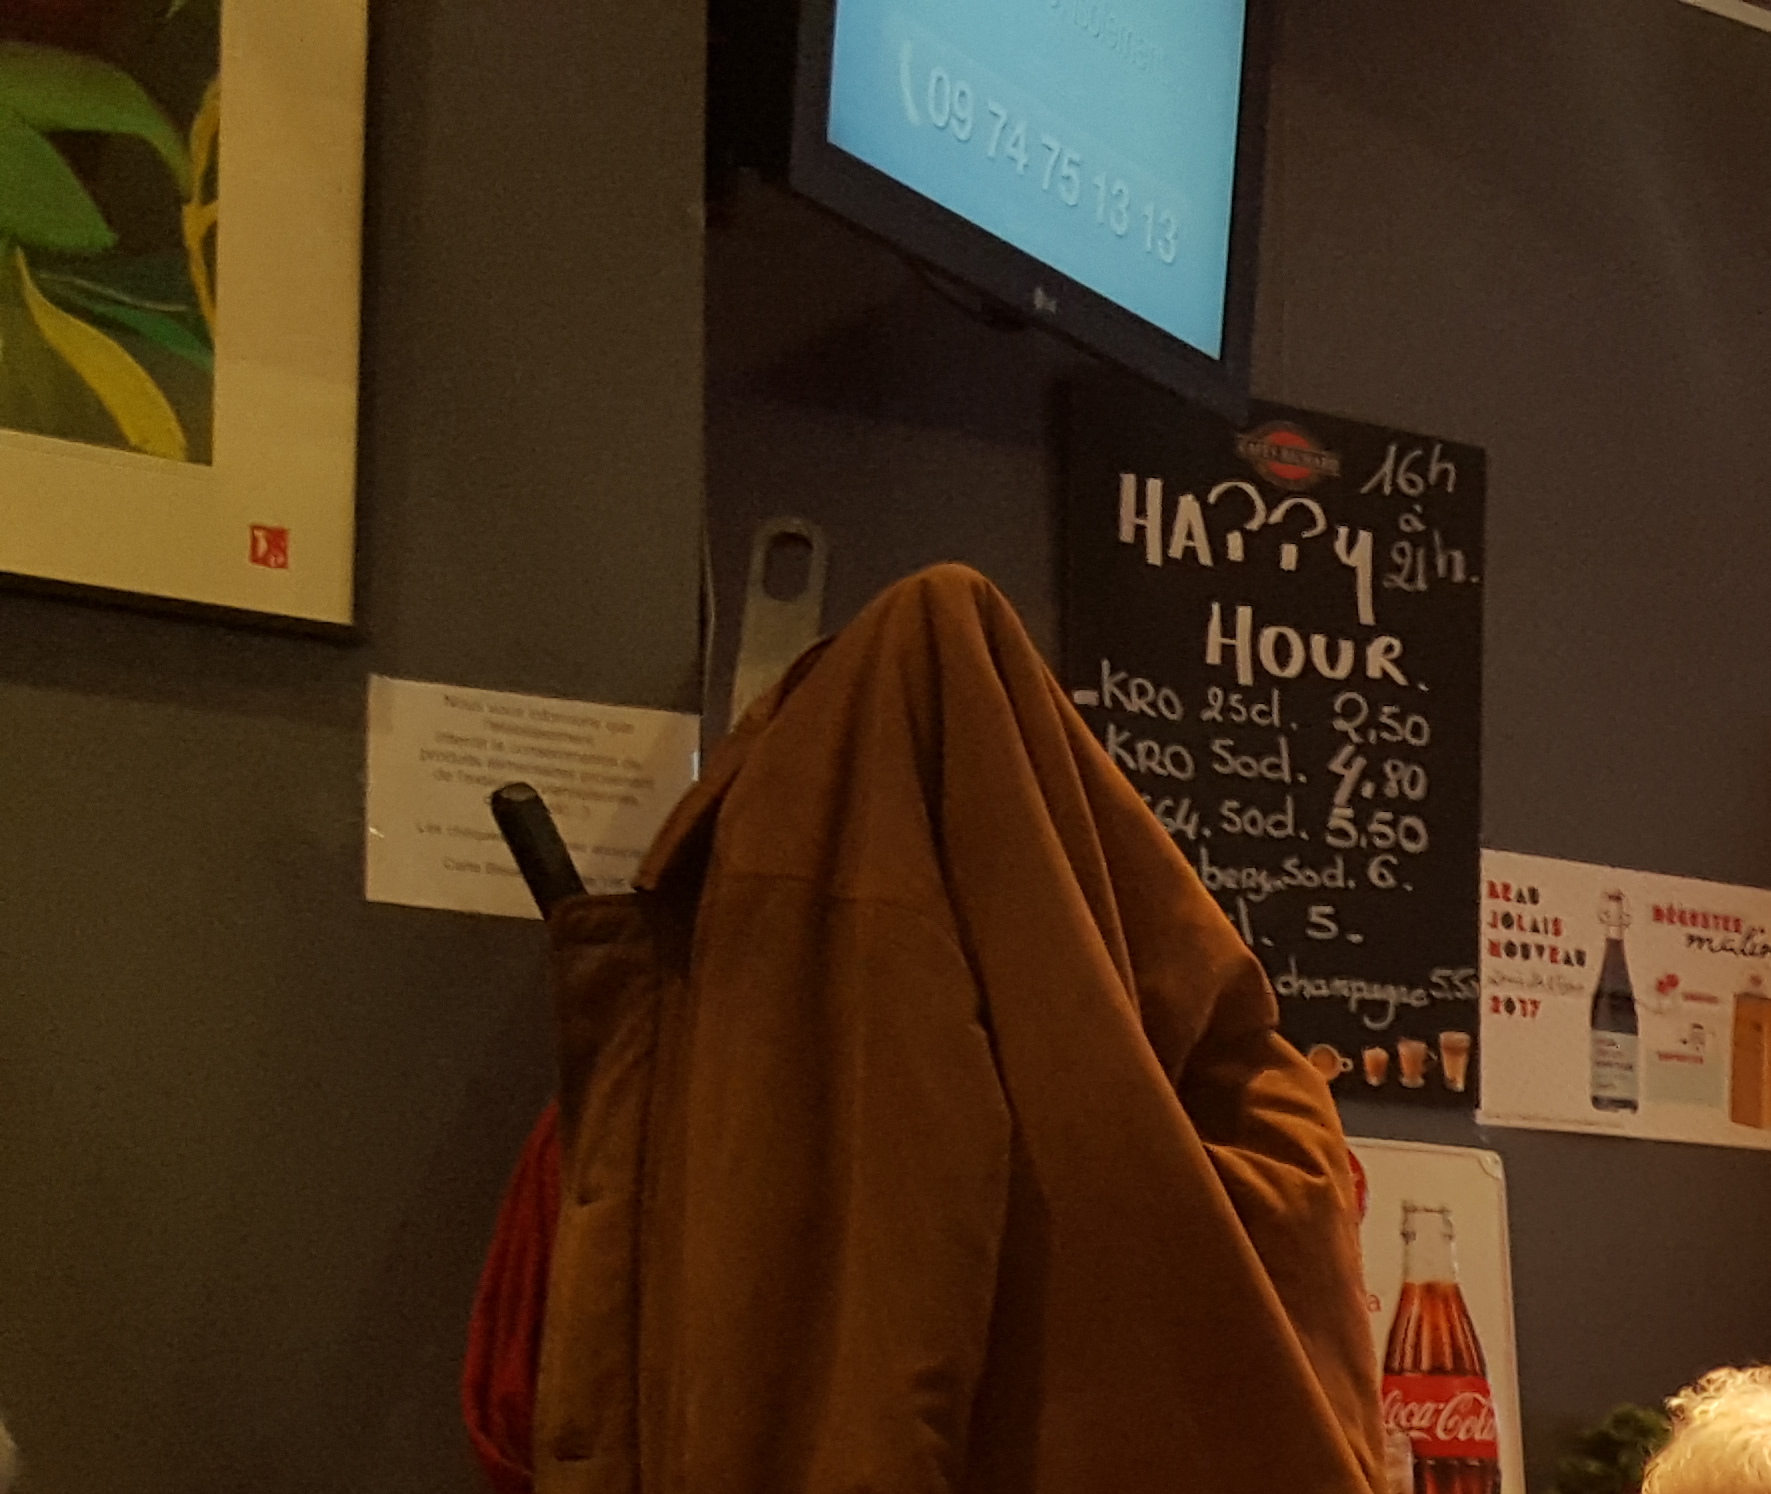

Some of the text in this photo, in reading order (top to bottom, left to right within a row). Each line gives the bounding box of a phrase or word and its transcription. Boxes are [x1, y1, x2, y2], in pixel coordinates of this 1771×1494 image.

[927, 66, 975, 142] 09
[986, 99, 1029, 176] 74
[1040, 134, 1081, 207] 75
